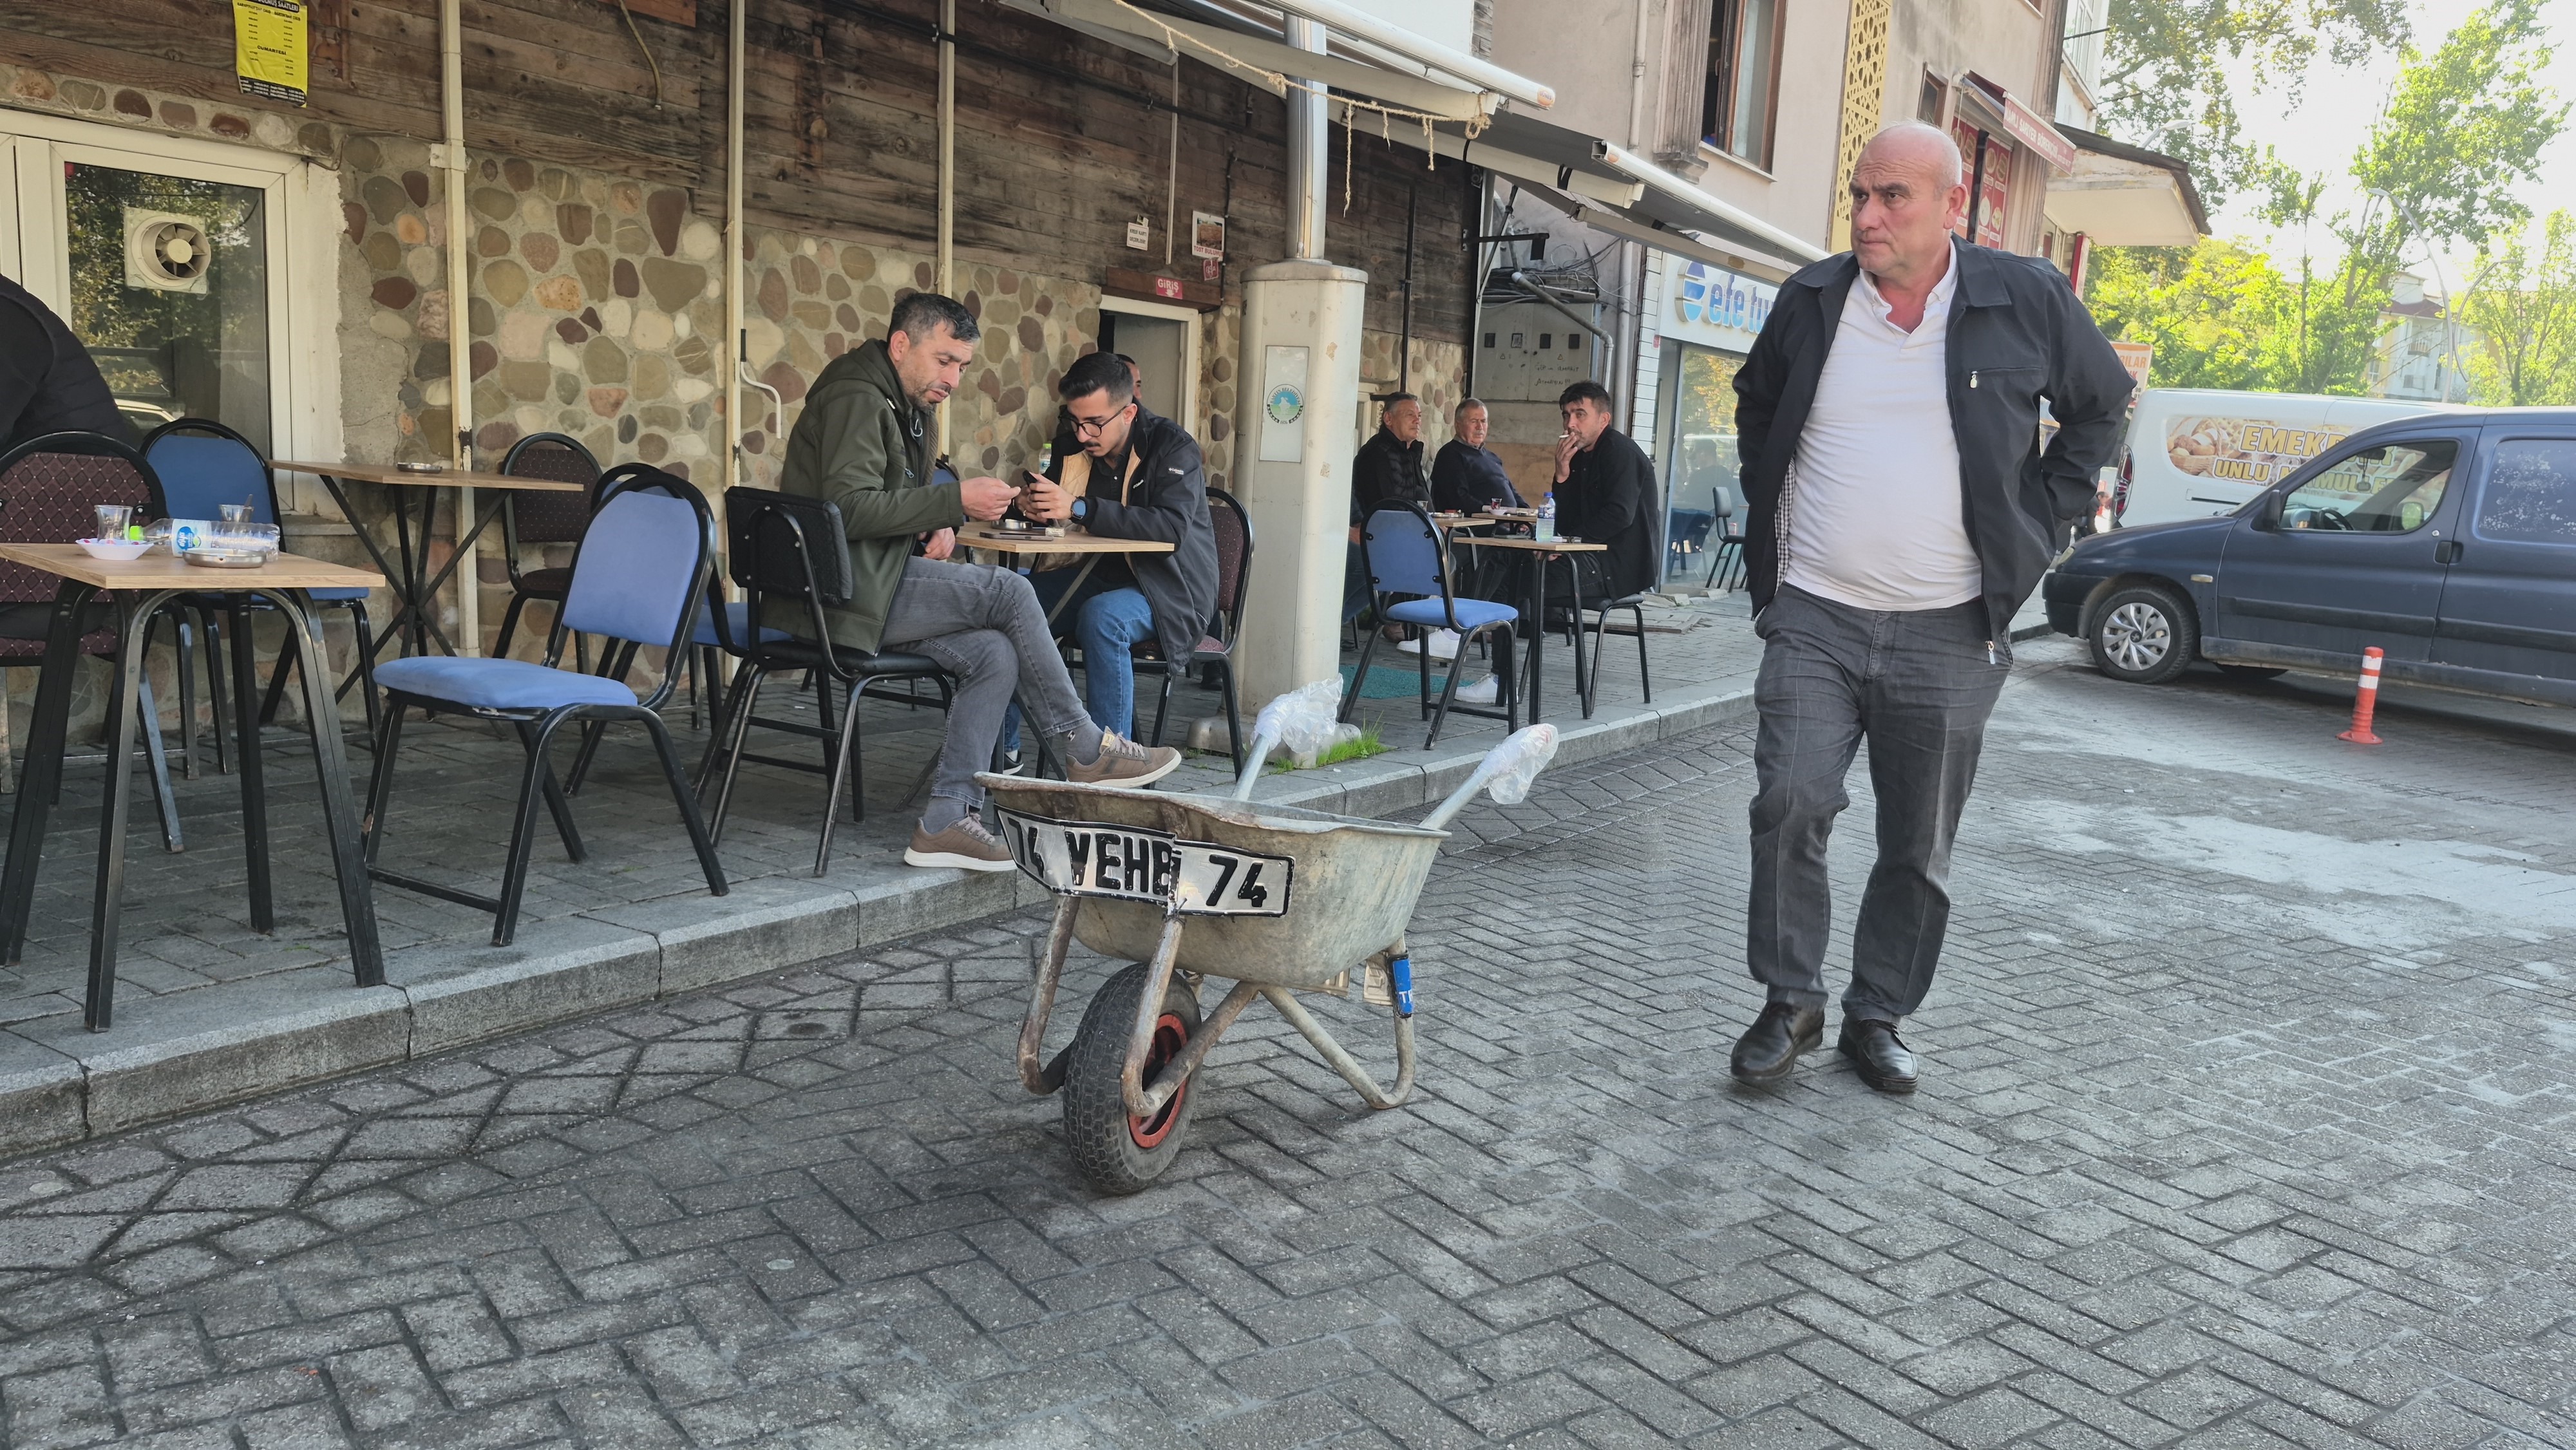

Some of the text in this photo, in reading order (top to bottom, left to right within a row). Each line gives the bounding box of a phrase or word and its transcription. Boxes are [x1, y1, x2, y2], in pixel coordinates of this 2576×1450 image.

[1708, 273, 1775, 334] efe tu
[2214, 458, 2271, 482] UNLU
[1206, 853, 1267, 908] 74
